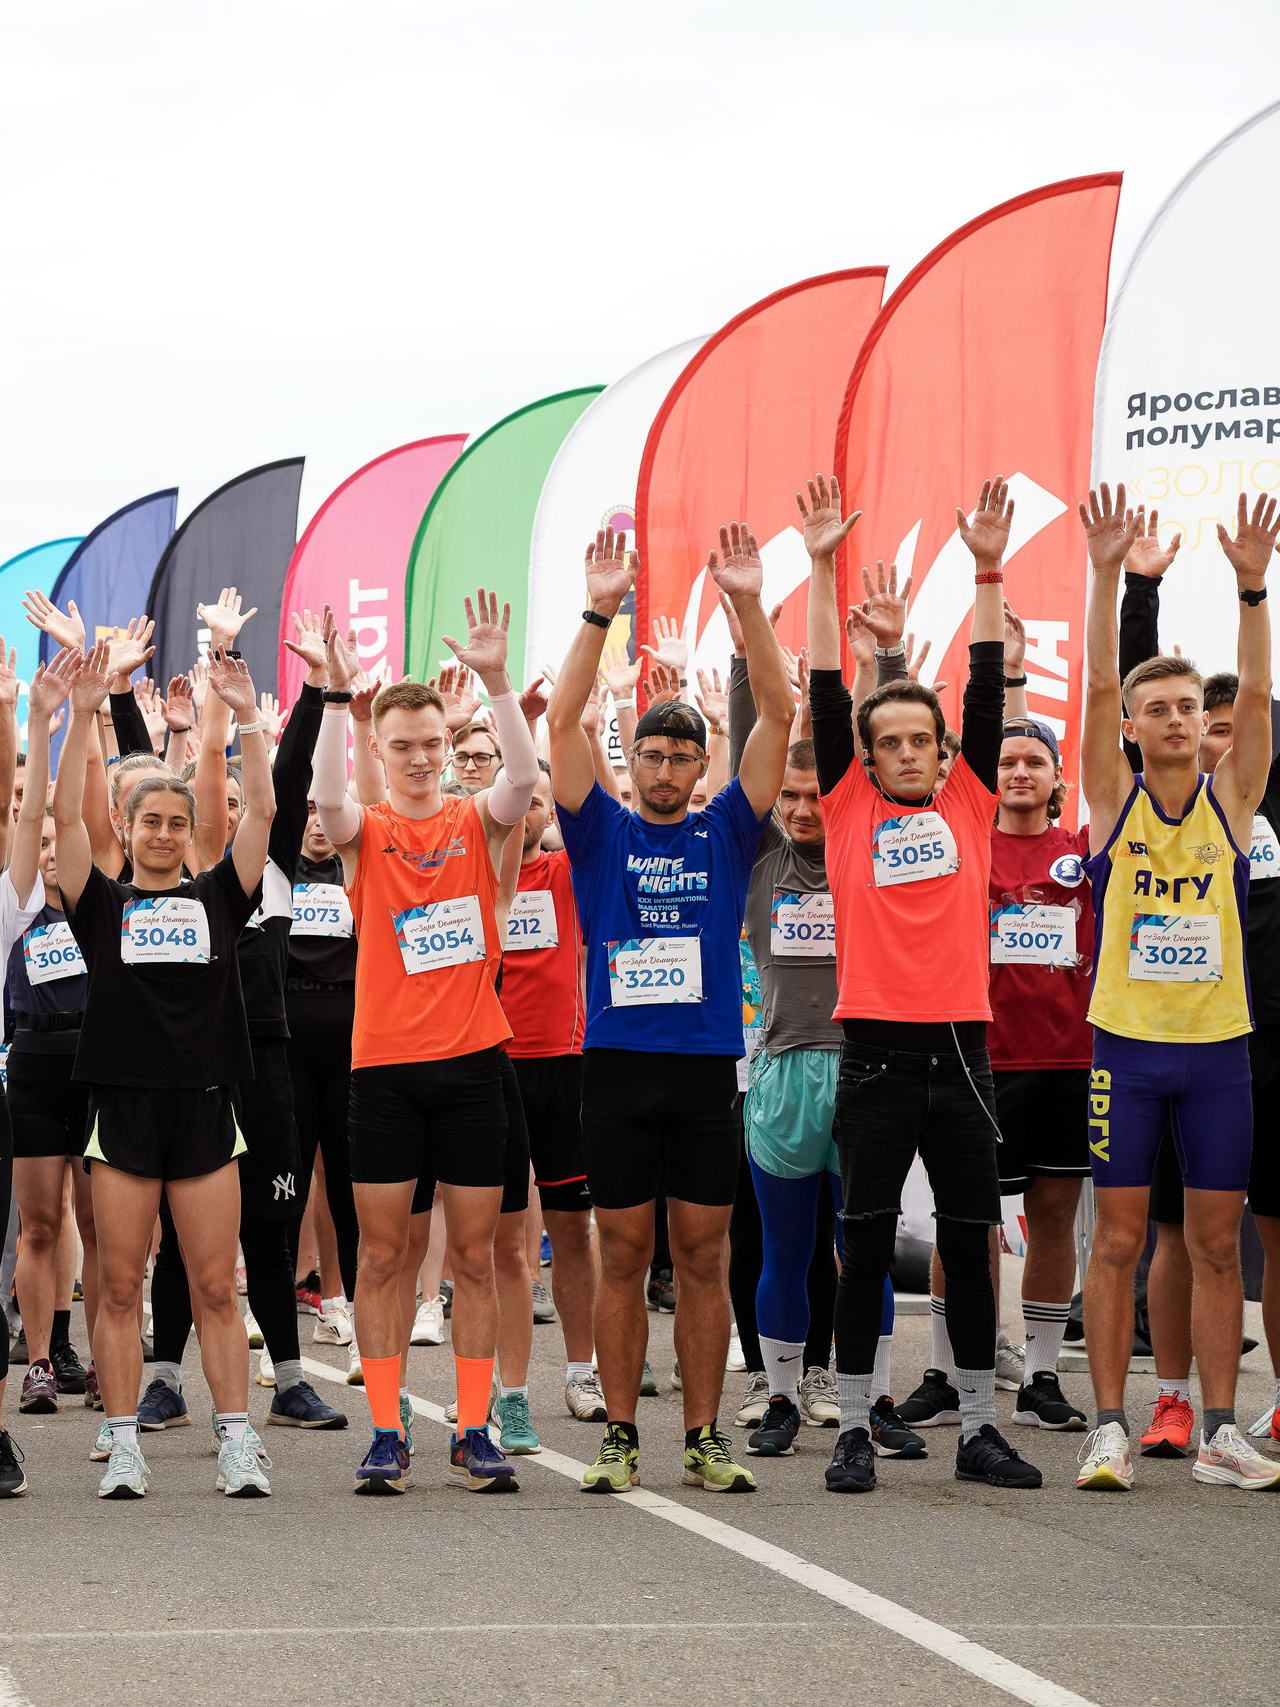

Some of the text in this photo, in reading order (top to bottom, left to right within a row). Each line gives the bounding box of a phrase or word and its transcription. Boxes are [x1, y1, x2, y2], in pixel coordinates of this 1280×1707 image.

[1127, 387, 1280, 421] Ярослав
[887, 841, 944, 867] 3055
[1249, 844, 1274, 862] 46
[627, 854, 684, 875] WHITE
[637, 872, 708, 893] NIGHTS
[1133, 869, 1213, 903] ЯРГУ
[654, 895, 708, 903] INTERNATIONAL
[293, 908, 340, 923] 3073
[640, 911, 680, 923] 2019
[507, 918, 541, 935] 212
[784, 923, 835, 940] 3023
[134, 928, 197, 946] 3048
[413, 928, 474, 955] 3054
[1004, 932, 1063, 950] 3007
[1145, 945, 1208, 965] 3022
[625, 968, 685, 989] 3220
[1089, 1068, 1111, 1162] ЯРГУ
